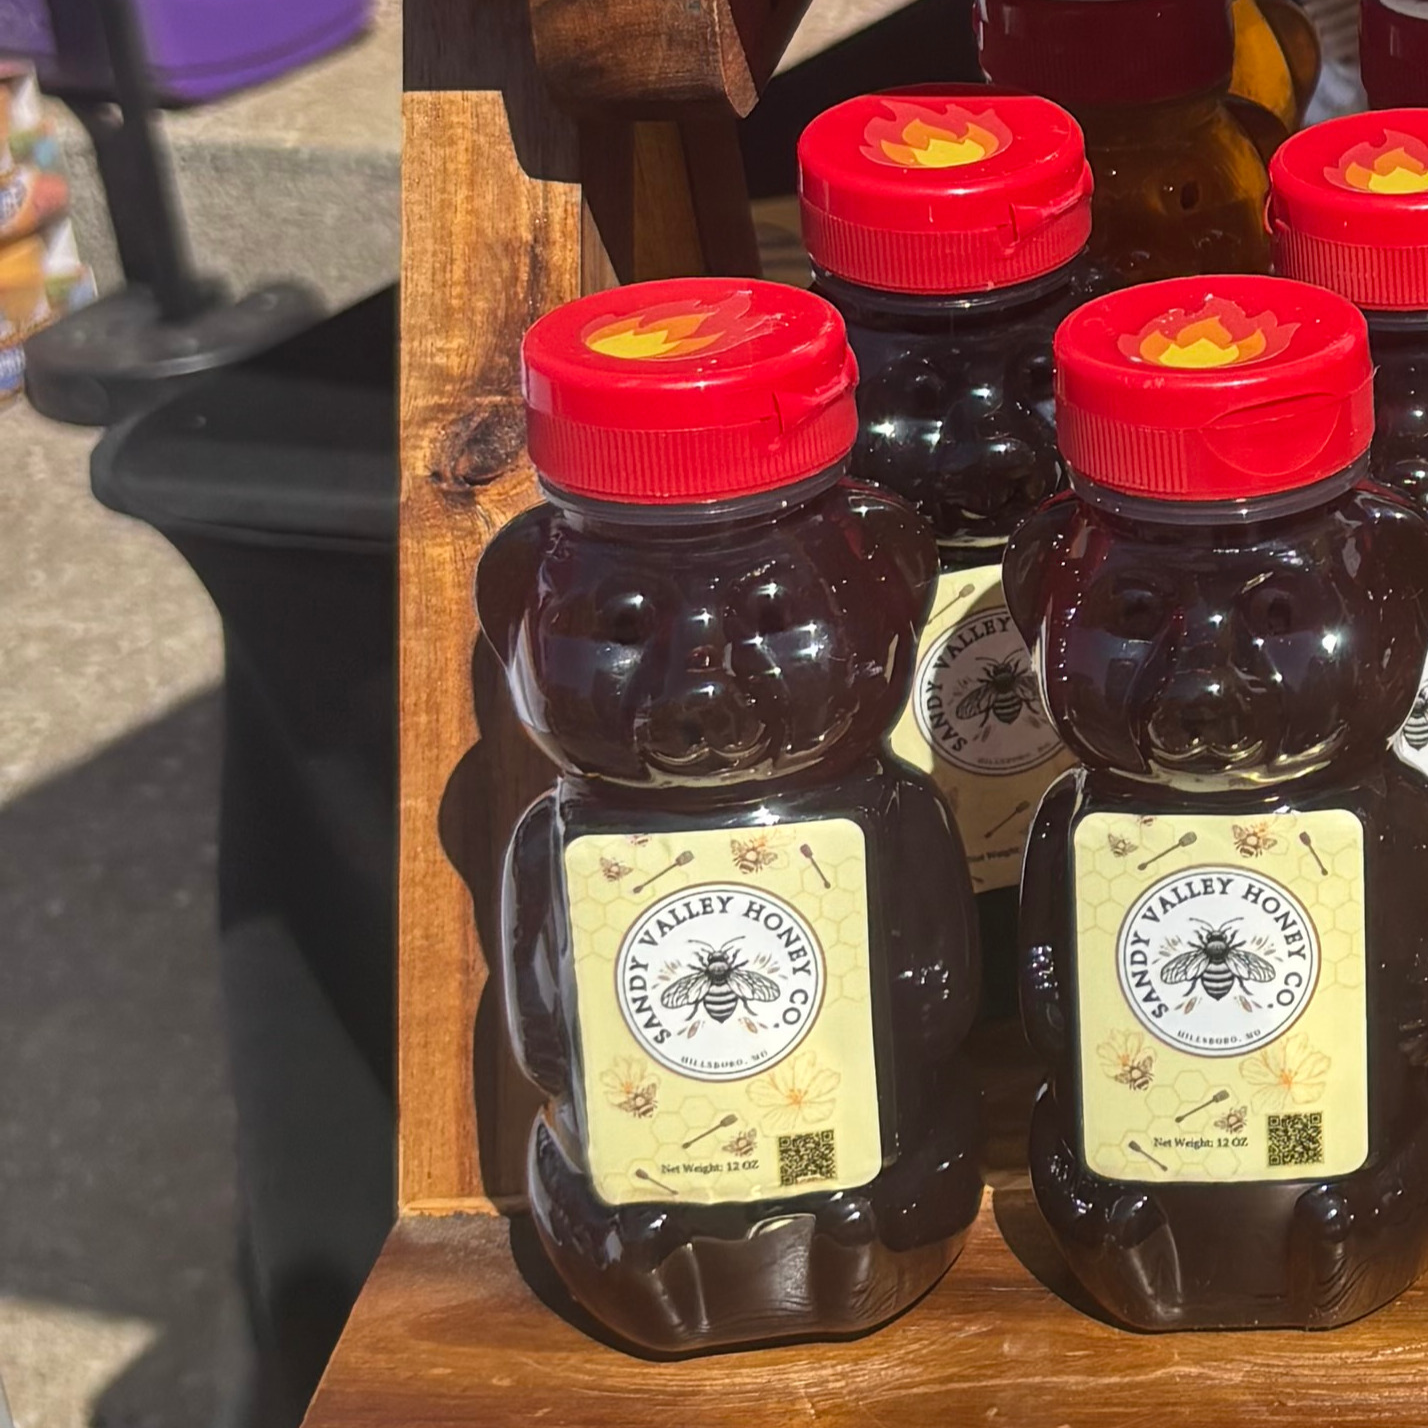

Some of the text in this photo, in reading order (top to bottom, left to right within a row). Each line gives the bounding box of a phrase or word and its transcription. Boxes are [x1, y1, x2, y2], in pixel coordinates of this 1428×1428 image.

[925, 616, 1014, 753] SANDY VALLEY
[642, 895, 735, 947] VALLEY
[1141, 876, 1235, 925] VALLEY
[1241, 883, 1307, 962] HONEY
[742, 902, 812, 977] HONEY
[1128, 929, 1170, 1020] SANDY
[627, 955, 674, 1046] SANDY
[726, 1161, 741, 1172] 12
[741, 1159, 760, 1170] OZ
[1153, 1135, 1249, 1149] Net Weight: 12 OZ
